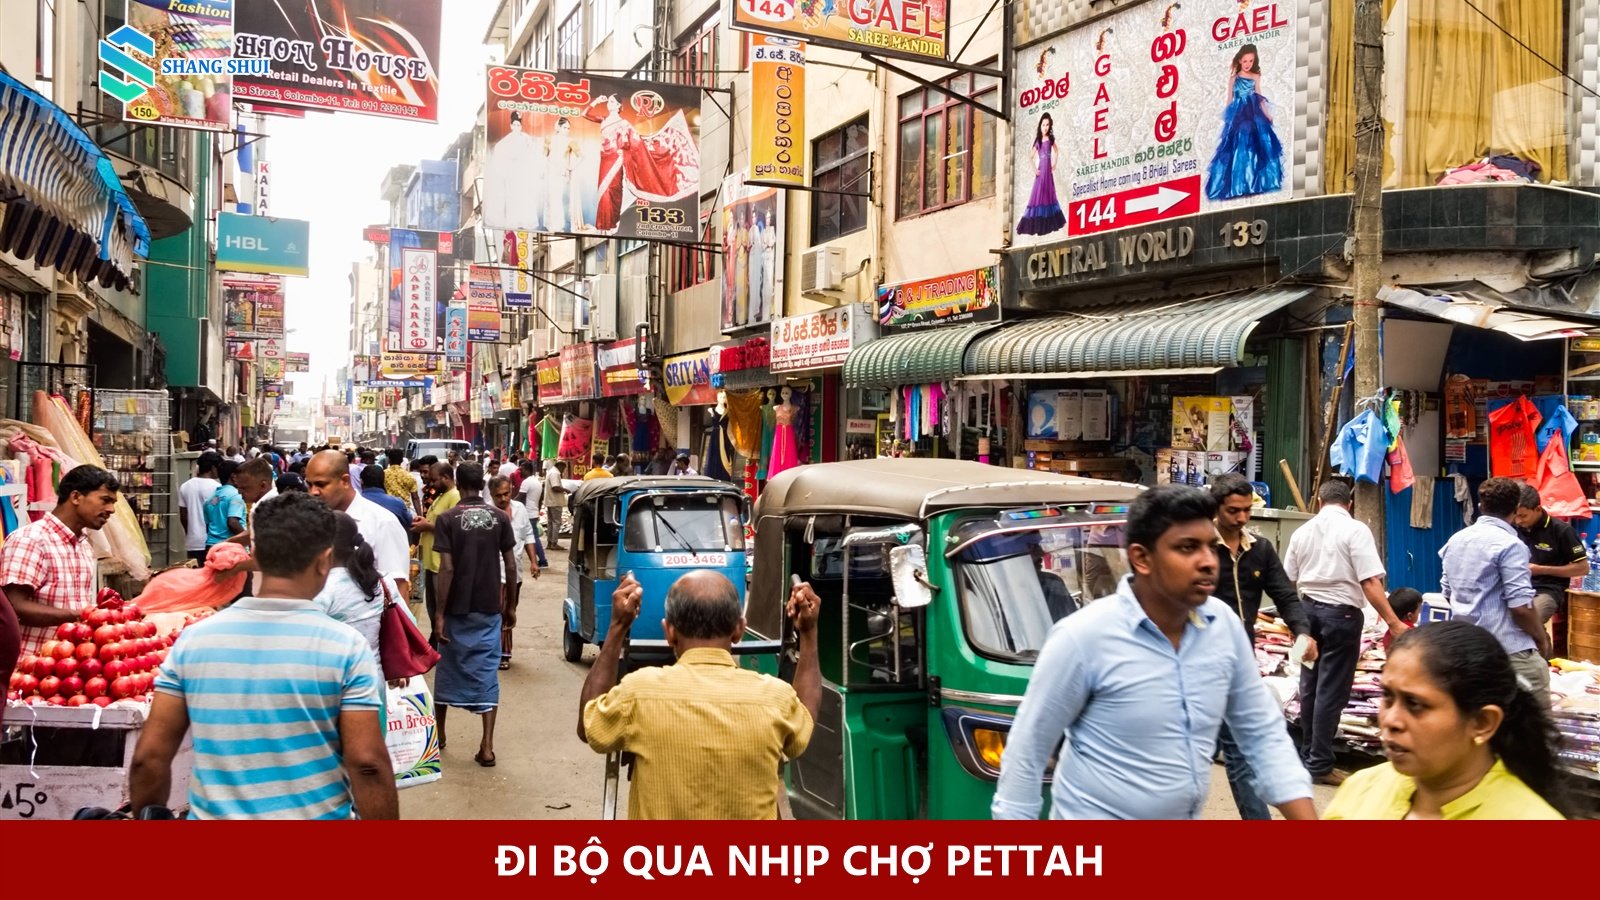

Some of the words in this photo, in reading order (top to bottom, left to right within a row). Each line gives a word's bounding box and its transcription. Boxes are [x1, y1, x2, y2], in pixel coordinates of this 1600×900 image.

[168, 0, 230, 18] Fashion
[747, 0, 786, 18] 144
[849, 0, 942, 39] GAEL
[1212, 4, 1288, 42] GAEL
[849, 27, 890, 47] SAREE
[892, 36, 941, 56] MANDIR
[1218, 38, 1244, 51] SAREE
[1247, 30, 1280, 42] MANDIR
[234, 33, 317, 71] HION
[321, 35, 428, 81] HOUSE
[268, 70, 299, 82] Retail
[302, 75, 344, 89] Dealers
[346, 79, 357, 90] In
[360, 82, 398, 96] Textile
[250, 86, 282, 100] Street,
[343, 98, 359, 108] Tel:
[361, 101, 378, 110] 011
[1093, 54, 1111, 160] GAEL
[134, 107, 152, 118] 150
[1076, 163, 1100, 177] SAREE
[1101, 156, 1130, 172] MANDIR
[1100, 176, 1117, 189] Home
[1142, 166, 1148, 180] &
[1149, 160, 1169, 178] Bridal
[1172, 158, 1197, 174] Sarees
[636, 199, 650, 207] No
[1076, 197, 1117, 229] 144
[636, 206, 685, 225] 133
[671, 225, 693, 233] Street,
[1219, 219, 1268, 248] 139
[225, 234, 270, 251] HBL
[1027, 243, 1107, 281] CENTRAL
[1119, 226, 1194, 266] WORLD
[906, 287, 914, 303] &
[917, 286, 923, 301] J
[925, 274, 975, 301] TRADING
[410, 275, 420, 337] APSARAS
[362, 396, 375, 405] 79
[665, 555, 725, 565] 200-3462
[405, 714, 434, 729] Bros
